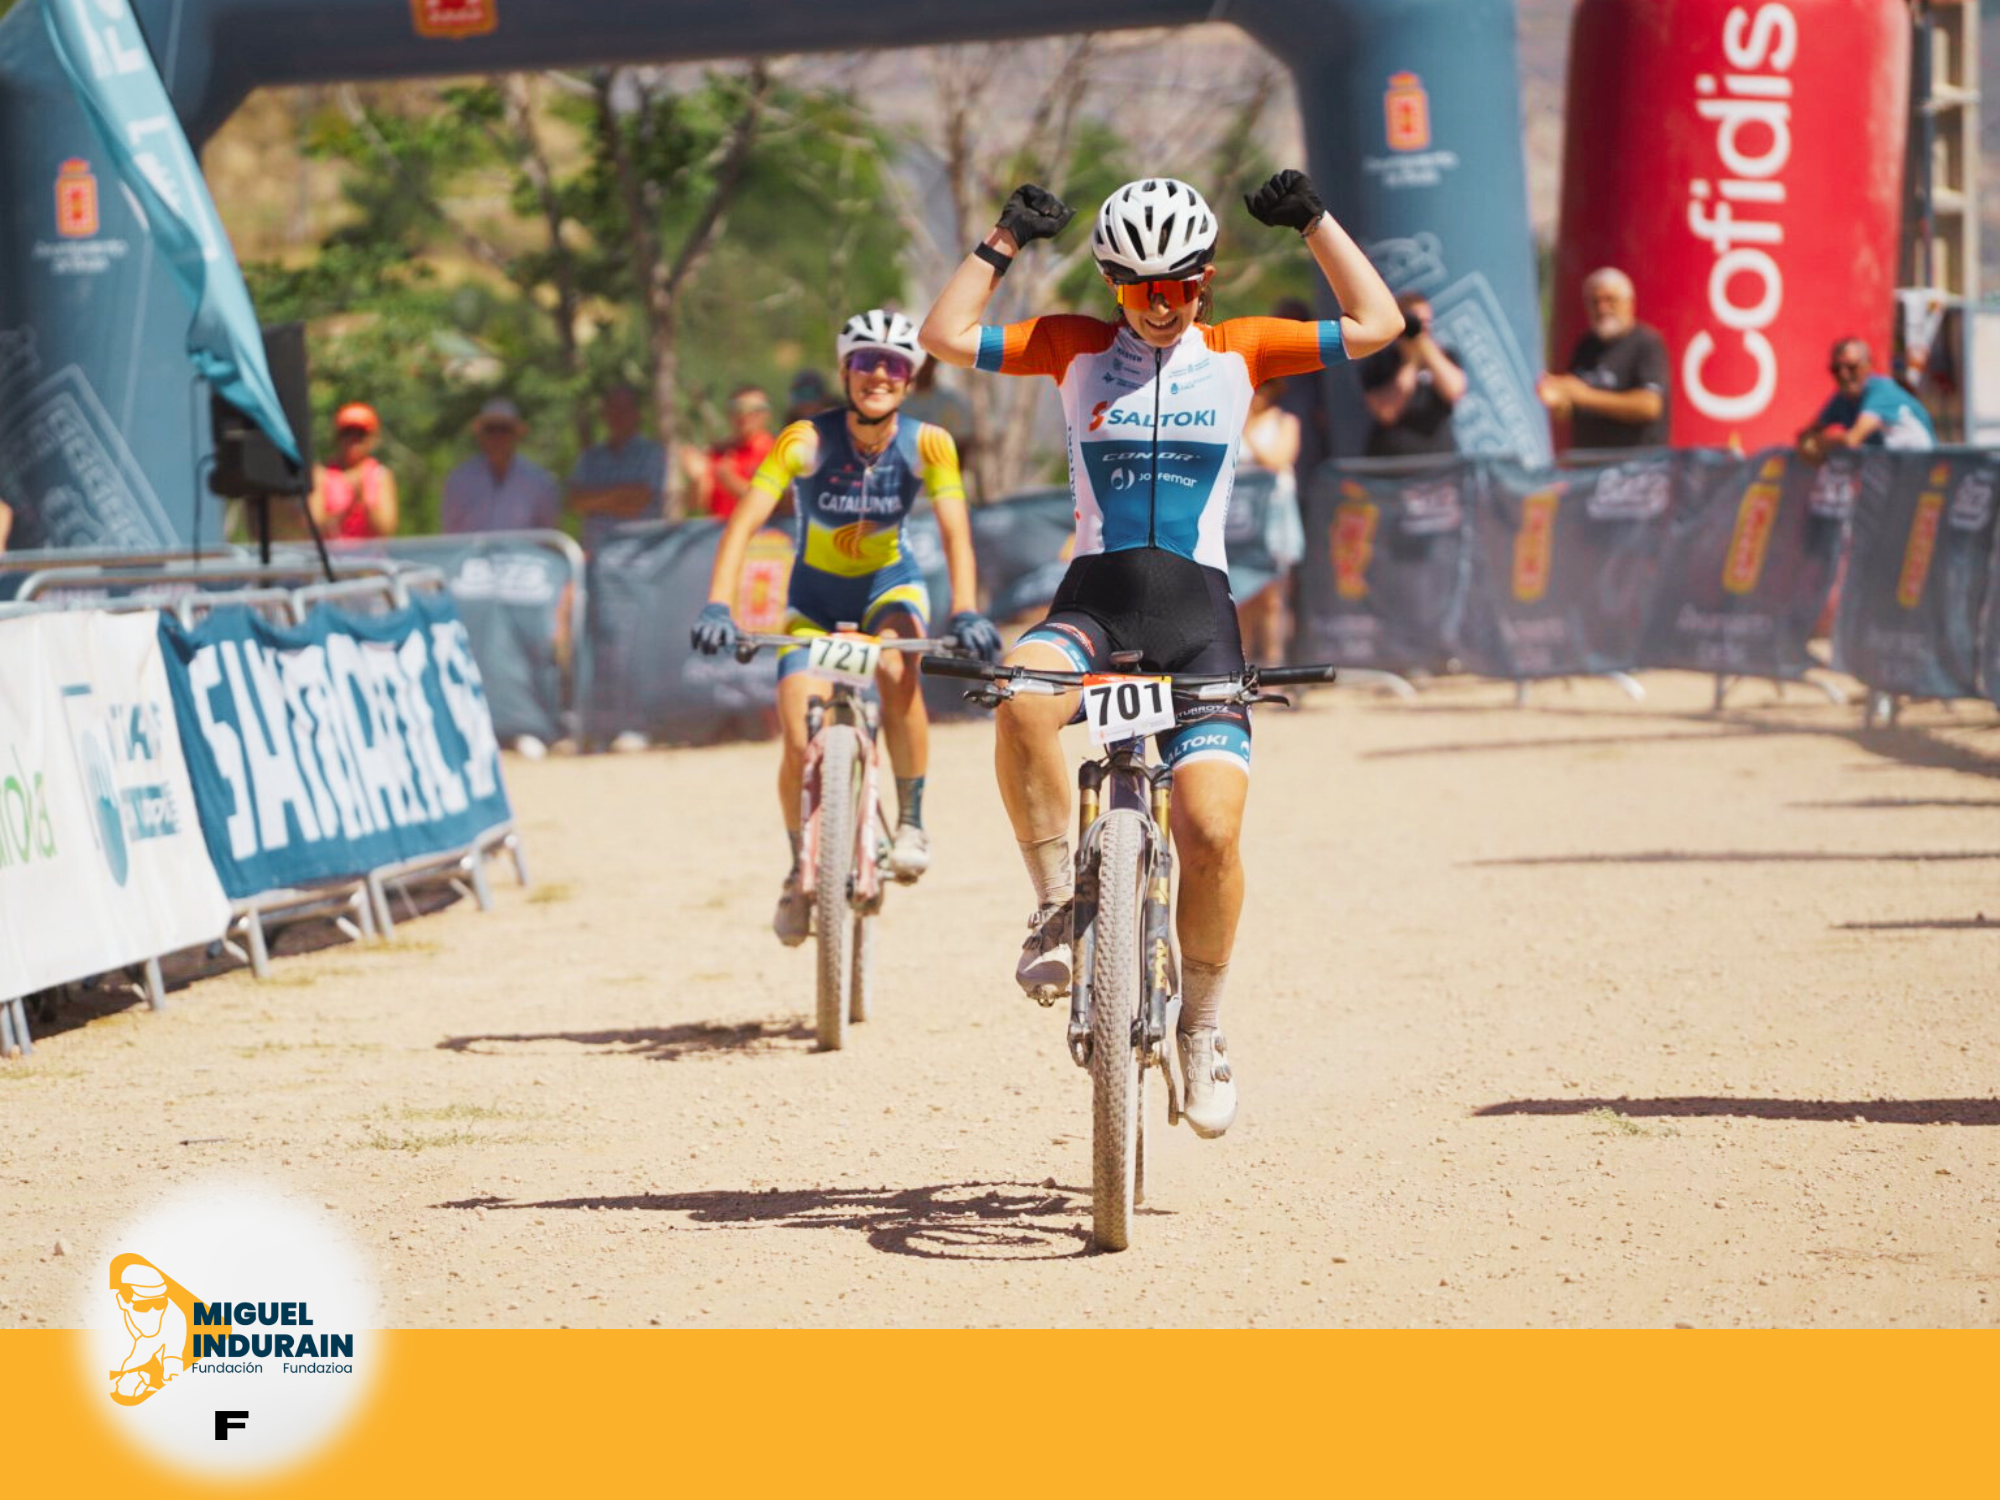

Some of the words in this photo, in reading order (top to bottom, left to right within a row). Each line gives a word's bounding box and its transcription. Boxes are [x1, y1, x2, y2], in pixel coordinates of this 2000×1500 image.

[1682, 2, 1798, 421] Cofidis
[1107, 409, 1216, 428] SALTOKI
[817, 491, 904, 514] CATALUNYA
[818, 638, 870, 675] 721
[1090, 682, 1163, 727] 701
